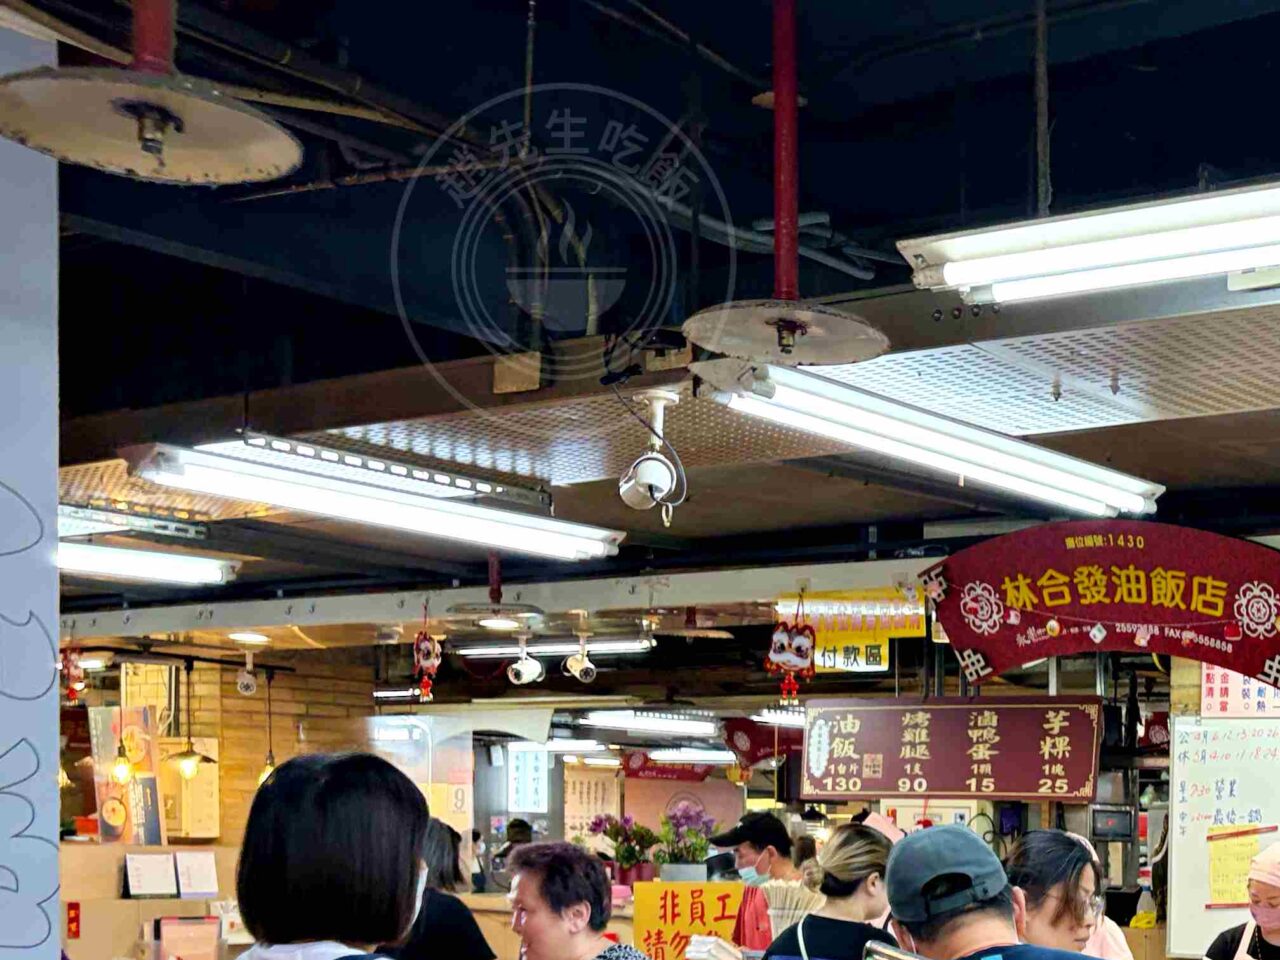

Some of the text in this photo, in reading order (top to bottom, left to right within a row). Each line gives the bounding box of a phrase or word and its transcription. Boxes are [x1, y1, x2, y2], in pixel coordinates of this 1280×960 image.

[1001, 564, 1230, 617] 林合發油飯店
[1164, 627, 1181, 640] FAX
[820, 644, 882, 669] 付款區
[831, 713, 861, 760] 油飯
[900, 711, 932, 760] 烤雞腿
[966, 711, 1000, 760] 滷鴨蛋
[1039, 711, 1072, 760] 芋粿
[822, 777, 862, 791] 130
[898, 778, 928, 792] 90
[966, 778, 996, 792] 15
[1038, 779, 1069, 793] 25
[658, 888, 737, 926] 非員工
